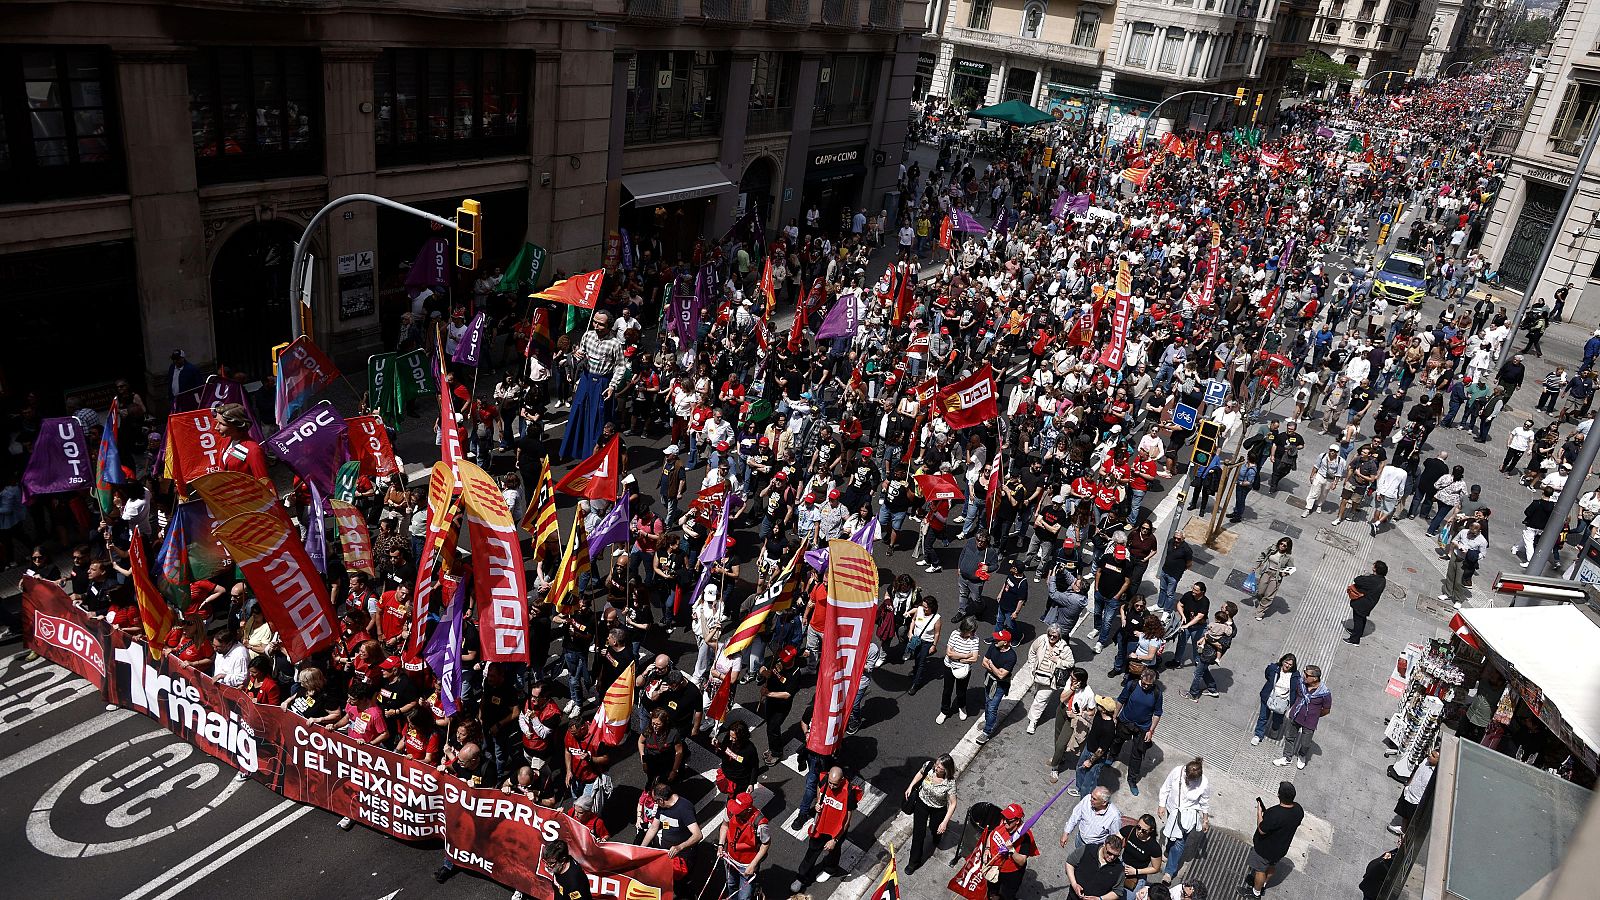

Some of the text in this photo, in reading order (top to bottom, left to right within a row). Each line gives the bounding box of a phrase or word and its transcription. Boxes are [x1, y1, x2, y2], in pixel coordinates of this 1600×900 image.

[1208, 383, 1223, 396] P
[286, 409, 335, 447] UGT
[1581, 565, 1600, 584] BAR
[172, 677, 200, 702] de
[168, 693, 258, 773] maig
[293, 746, 445, 811] I EL FEIXISME
[294, 725, 561, 842] CONTRA LES GUERRES
[359, 790, 447, 824] MÉS DRETS
[359, 807, 390, 828] MÉS
